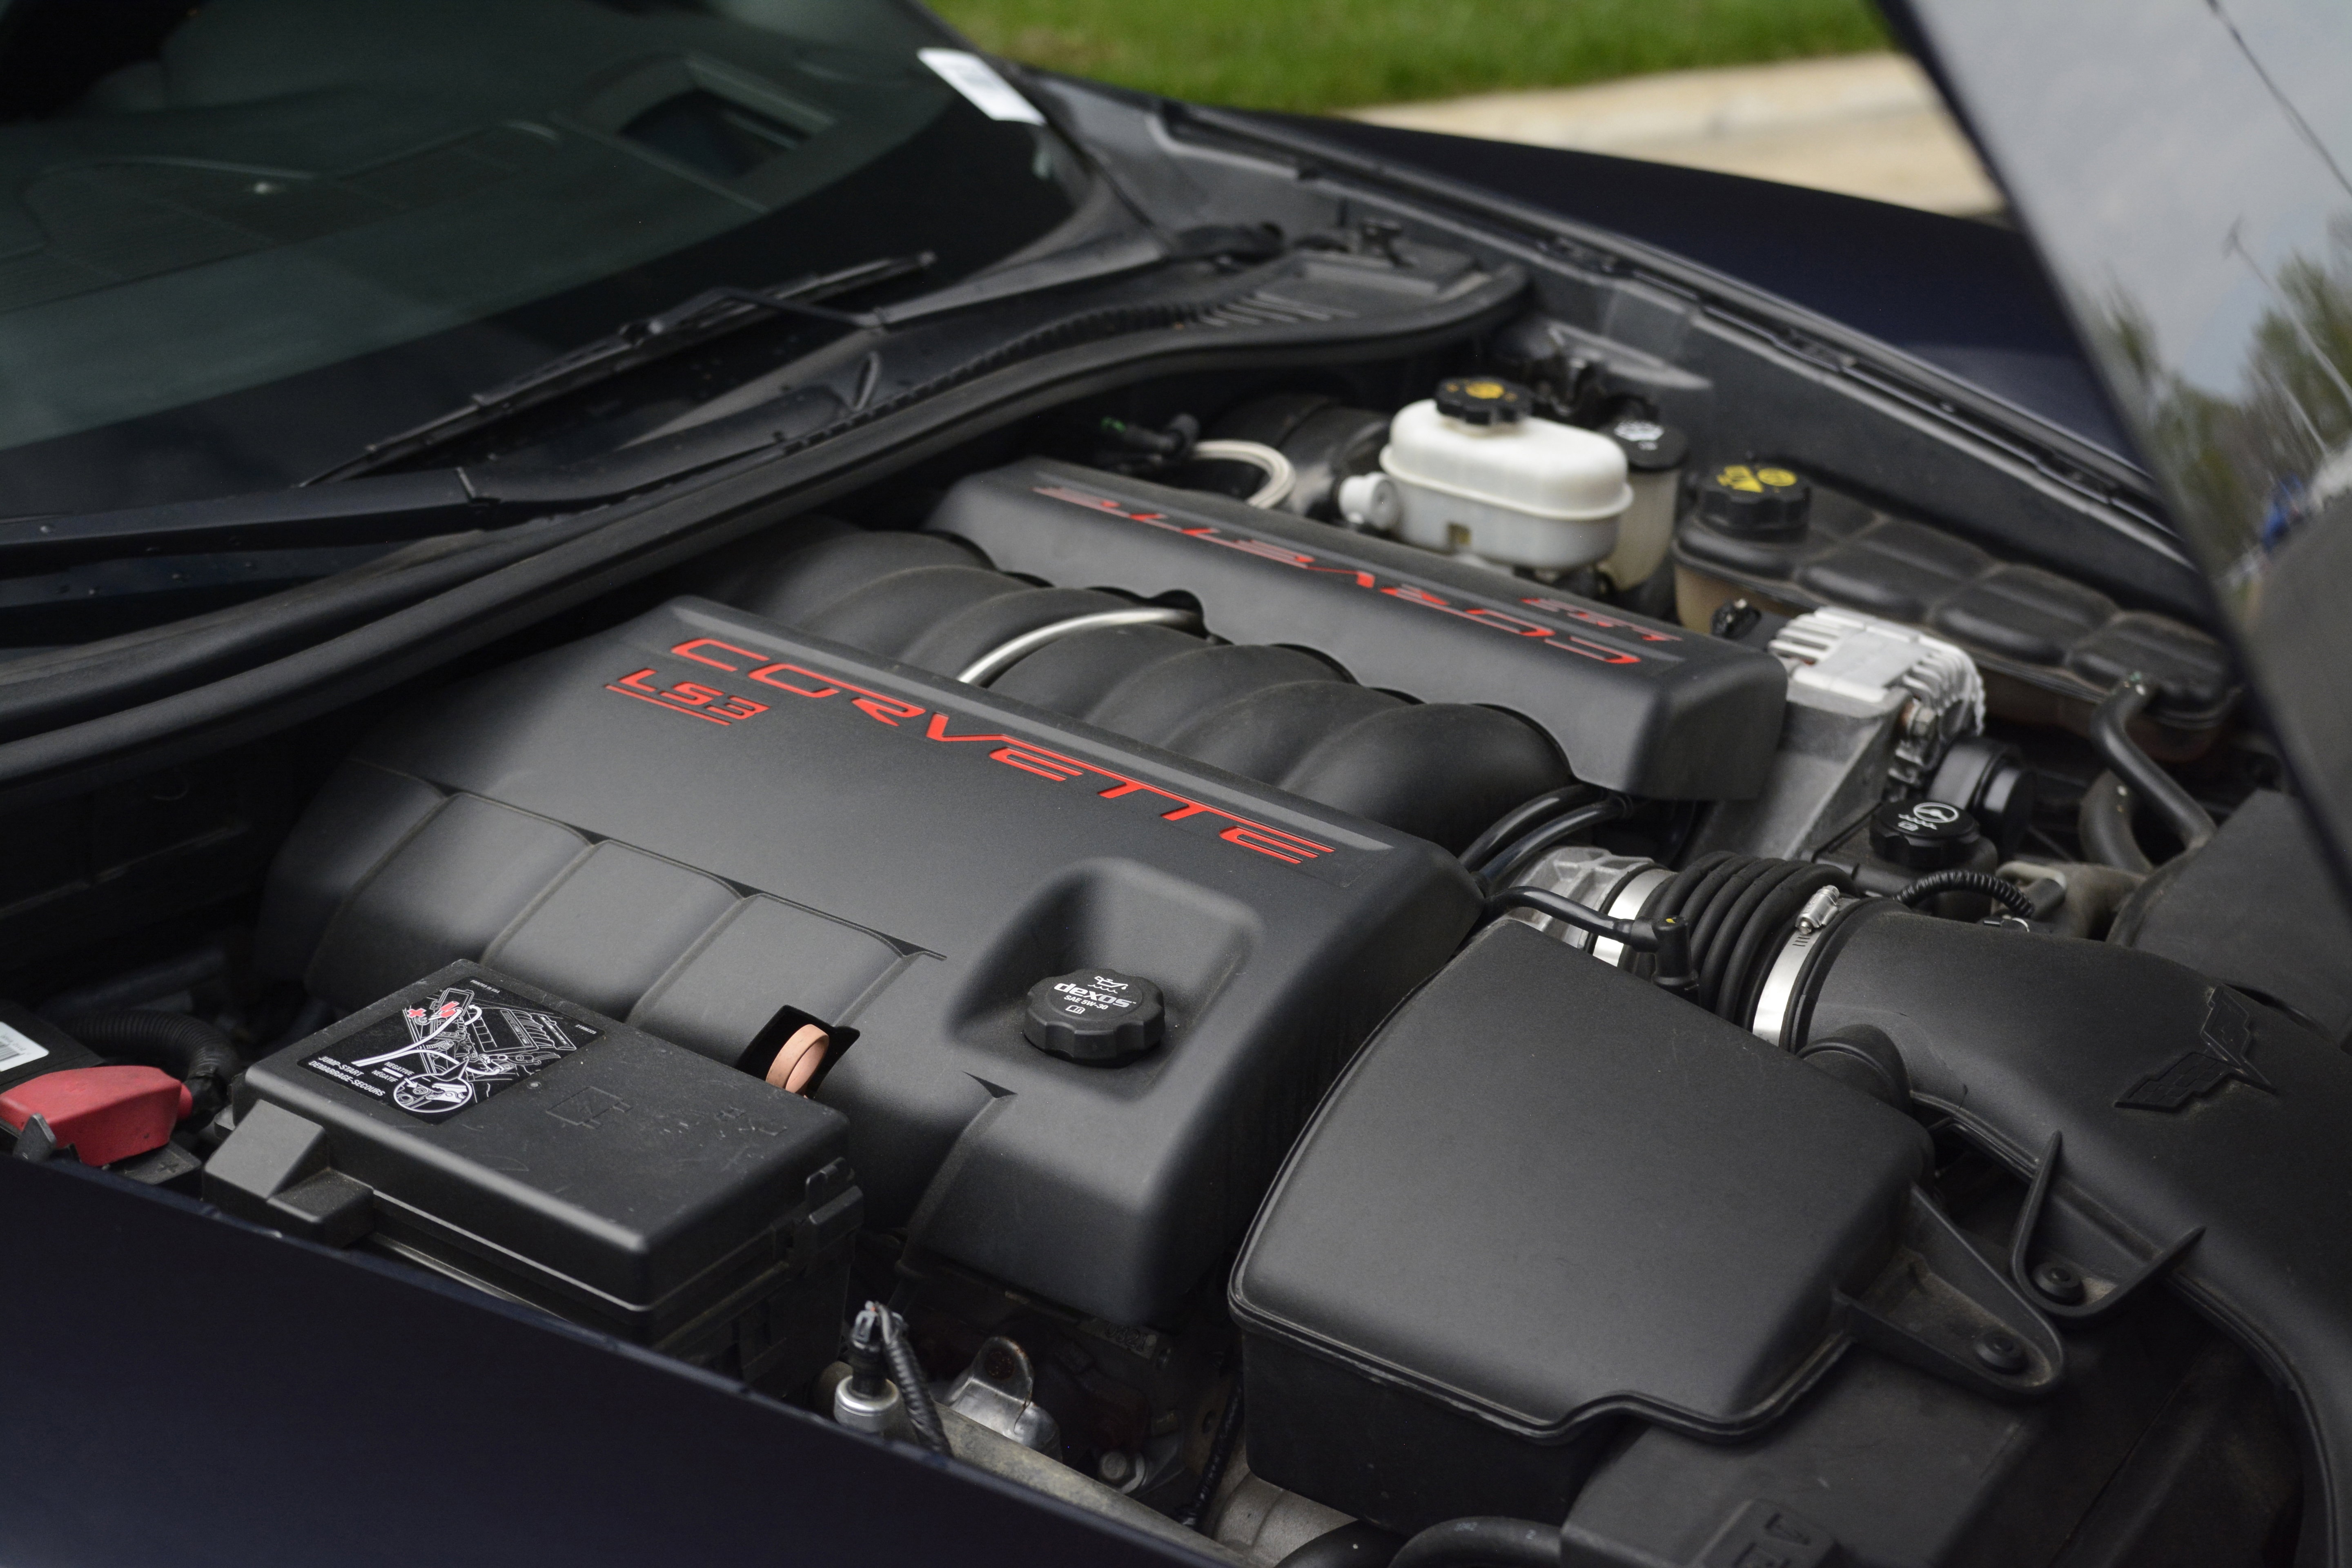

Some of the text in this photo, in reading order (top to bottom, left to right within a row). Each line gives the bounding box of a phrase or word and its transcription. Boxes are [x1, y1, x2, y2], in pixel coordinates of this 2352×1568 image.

[618, 668, 771, 720] LS3
[670, 637, 1335, 864] CORVETTE
[1054, 983, 1132, 1008] dexos
[1064, 995, 1109, 1010] SAE 5W-30
[308, 1060, 386, 1096] DEMARRAGE-SECOURS
[318, 1056, 364, 1077] JUMP-START
[384, 1061, 415, 1076] NEGATIVE
